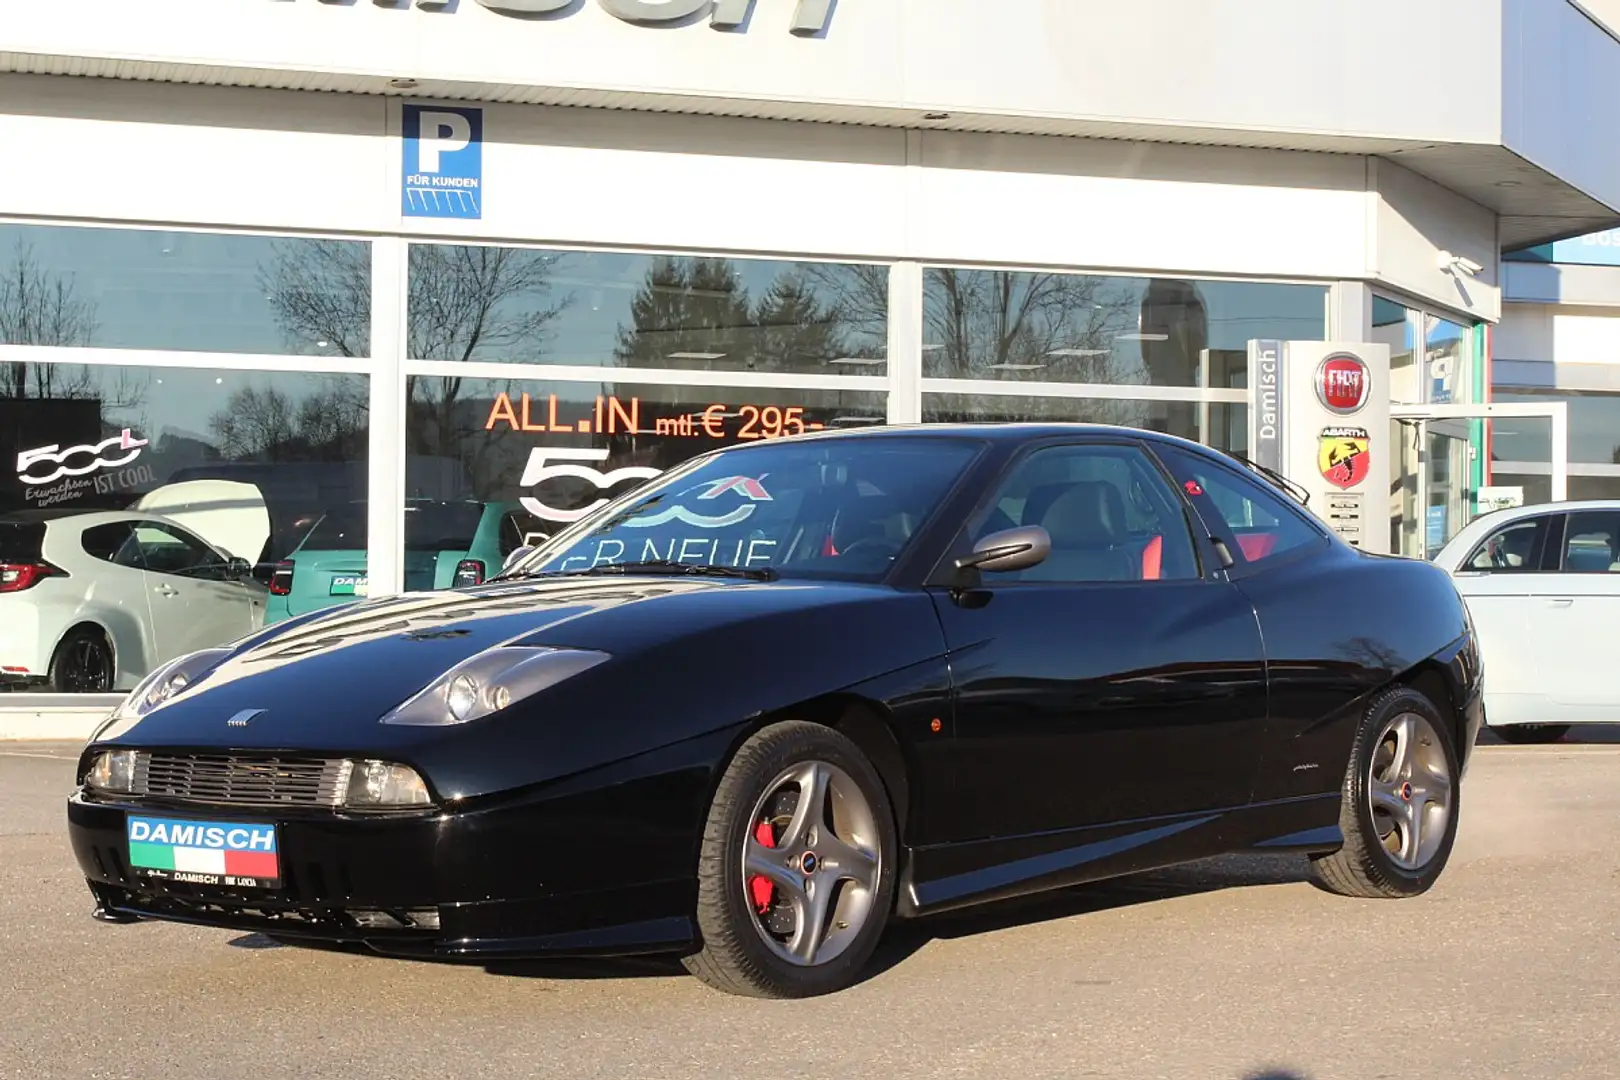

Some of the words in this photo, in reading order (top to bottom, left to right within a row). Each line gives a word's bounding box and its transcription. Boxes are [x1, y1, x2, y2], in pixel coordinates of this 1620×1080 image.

[418, 111, 471, 173] P
[407, 174, 430, 185] FÜR
[432, 176, 478, 188] KUNDEN
[1260, 349, 1276, 439] Damisch
[655, 414, 699, 437] mtl.
[701, 404, 727, 438] €
[1323, 428, 1366, 437] ABARTH
[25, 478, 93, 500] Erwachsen
[93, 473, 115, 494] IST
[118, 464, 158, 488] COOL
[38, 491, 83, 507] werden
[130, 821, 275, 850] DAMISCH
[174, 872, 219, 885] DAMISCH
